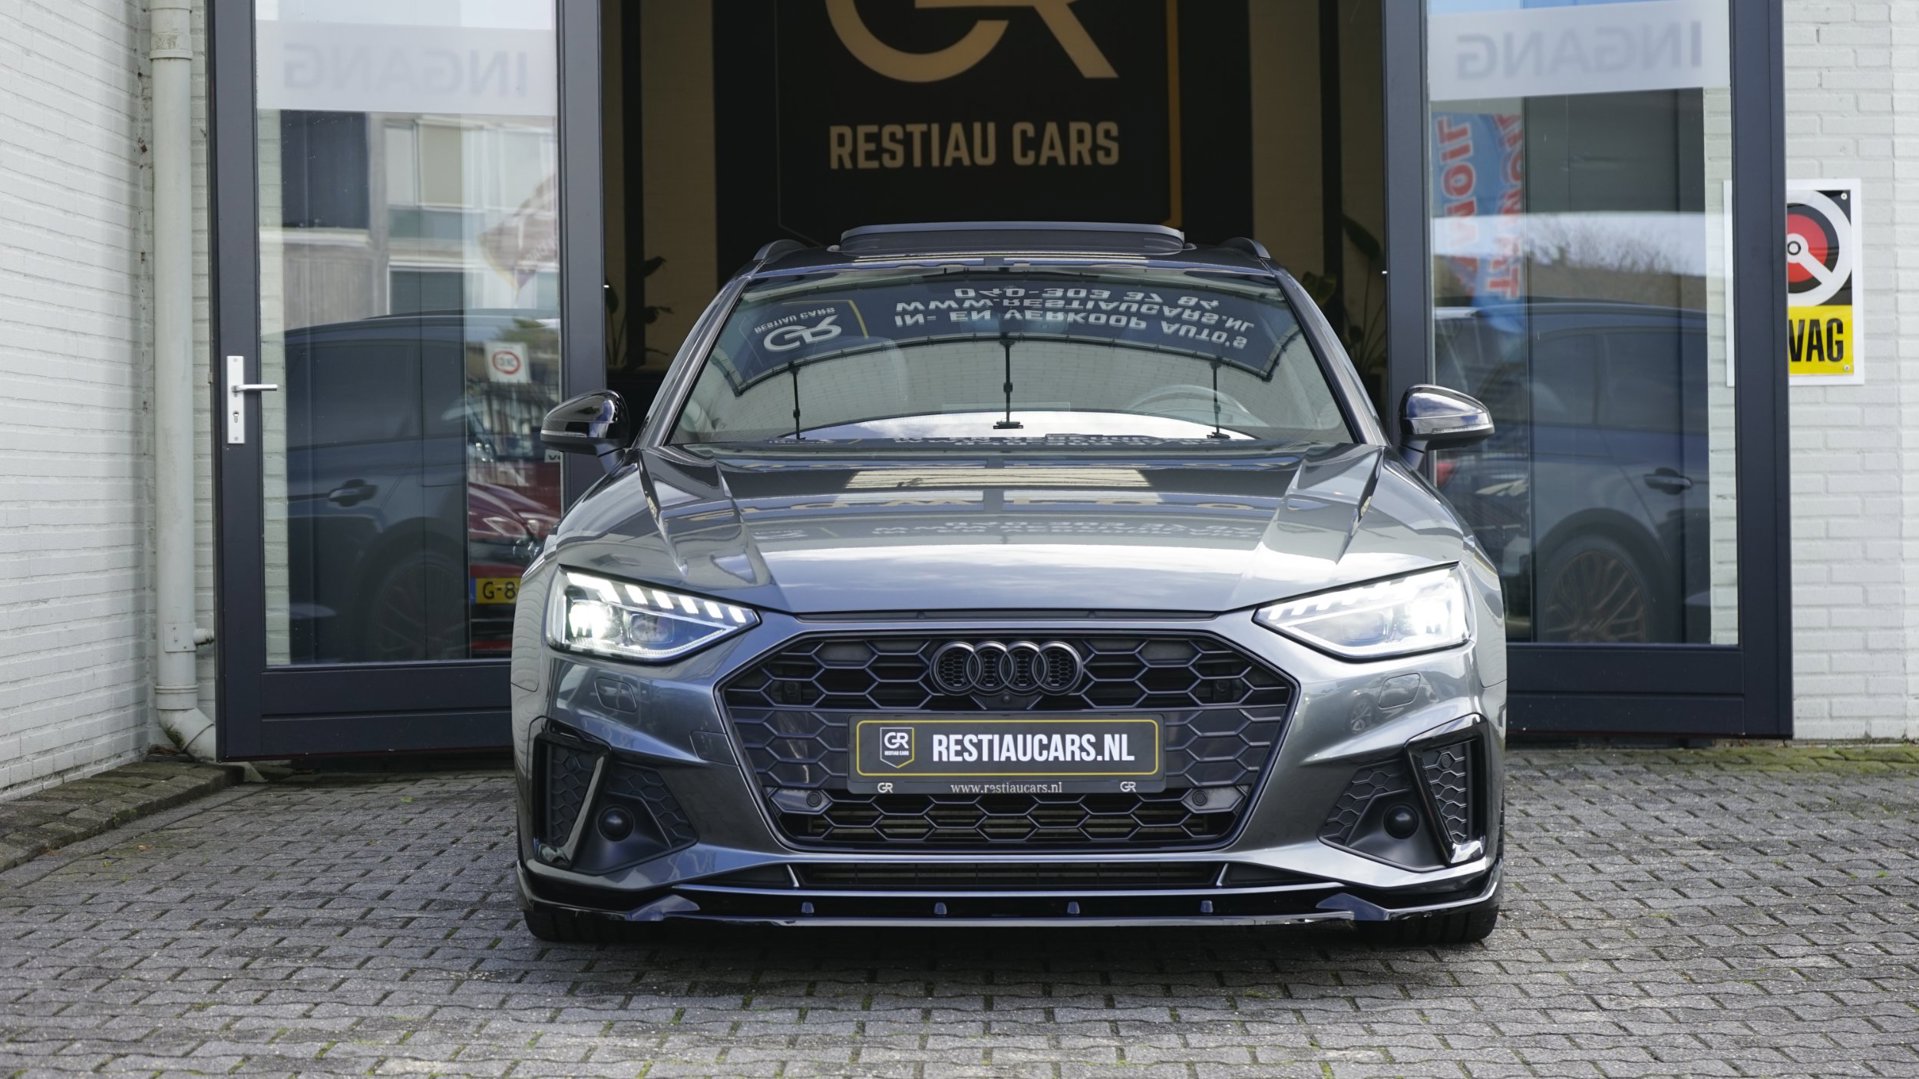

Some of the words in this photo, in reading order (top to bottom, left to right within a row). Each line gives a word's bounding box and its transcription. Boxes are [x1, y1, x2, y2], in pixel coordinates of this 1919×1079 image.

[829, 122, 997, 169] RESTIAU
[1012, 121, 1120, 166] CARS
[1788, 318, 1844, 363] VAG
[932, 733, 1136, 763] RESTIAUCARS.NL
[950, 781, 1063, 794] www.restiaucars.nl
